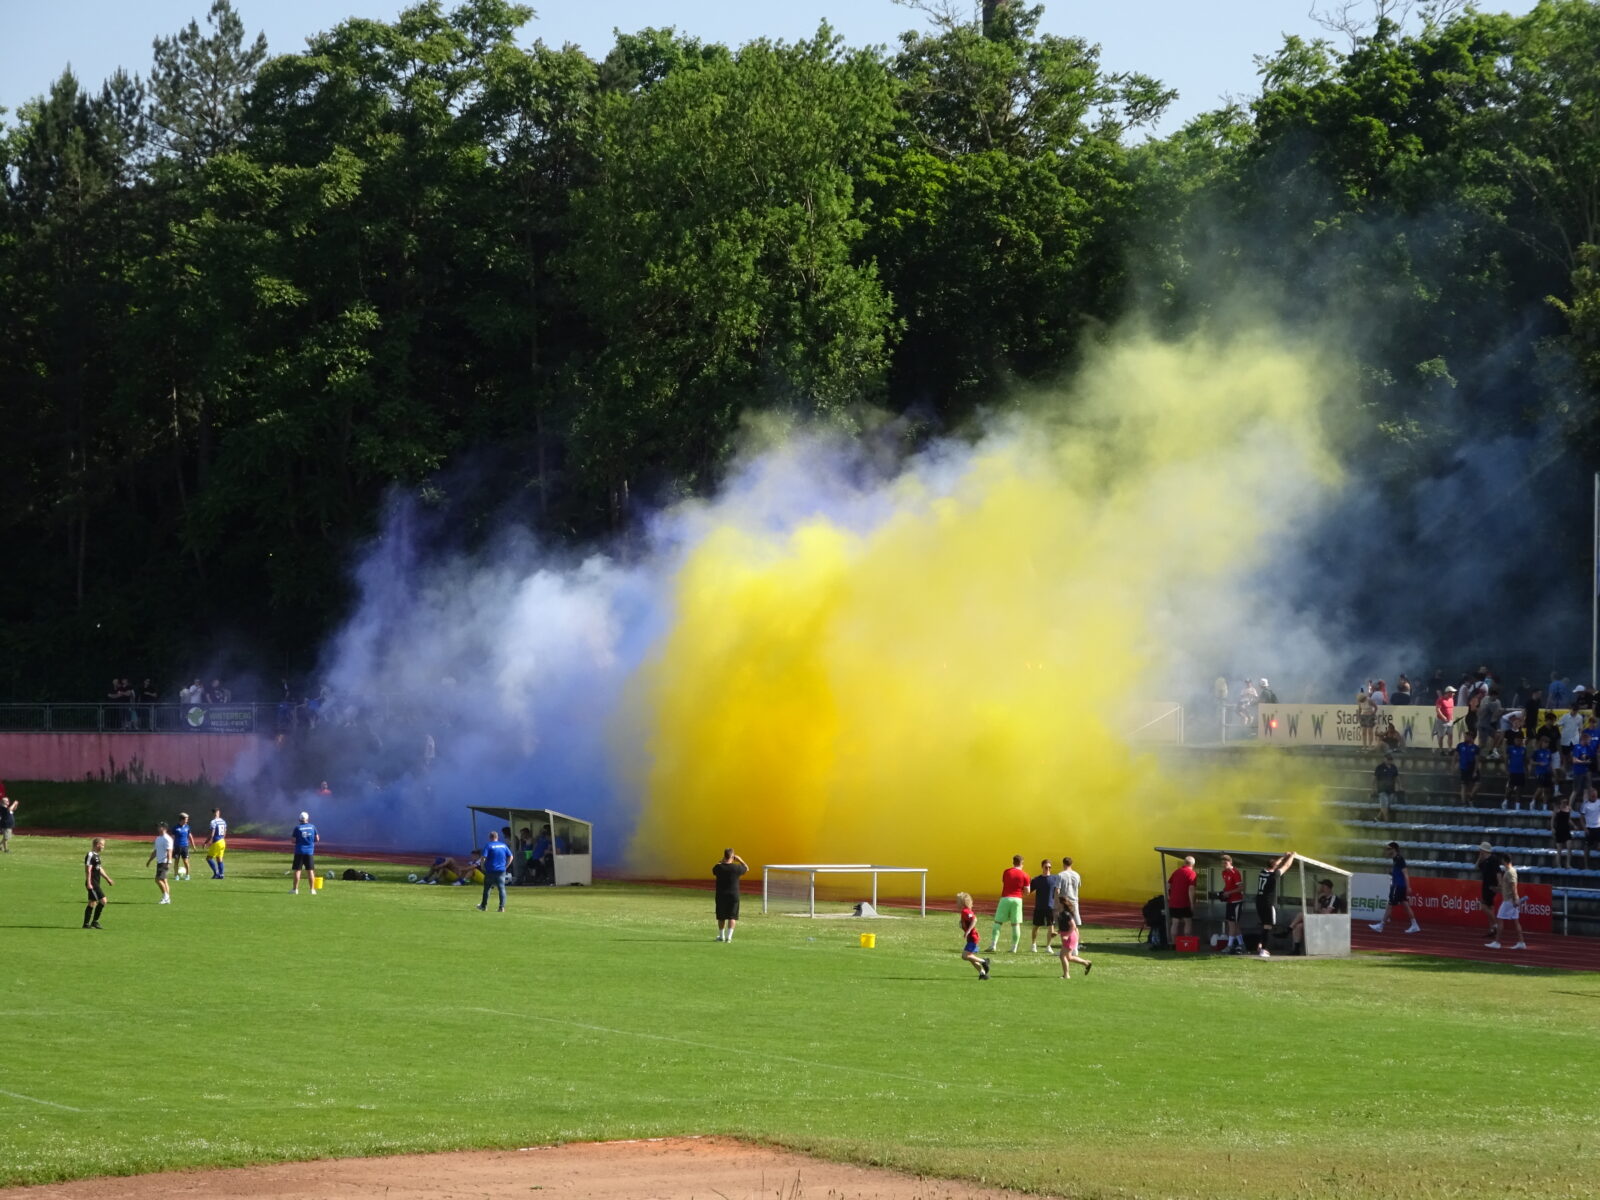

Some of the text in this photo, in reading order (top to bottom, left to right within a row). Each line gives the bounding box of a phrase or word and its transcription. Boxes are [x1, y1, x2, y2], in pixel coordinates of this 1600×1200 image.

[1425, 898, 1438, 908] um
[1441, 894, 1463, 910] Geld
[1464, 897, 1482, 913] geh
[1520, 899, 1551, 916] rkasse
